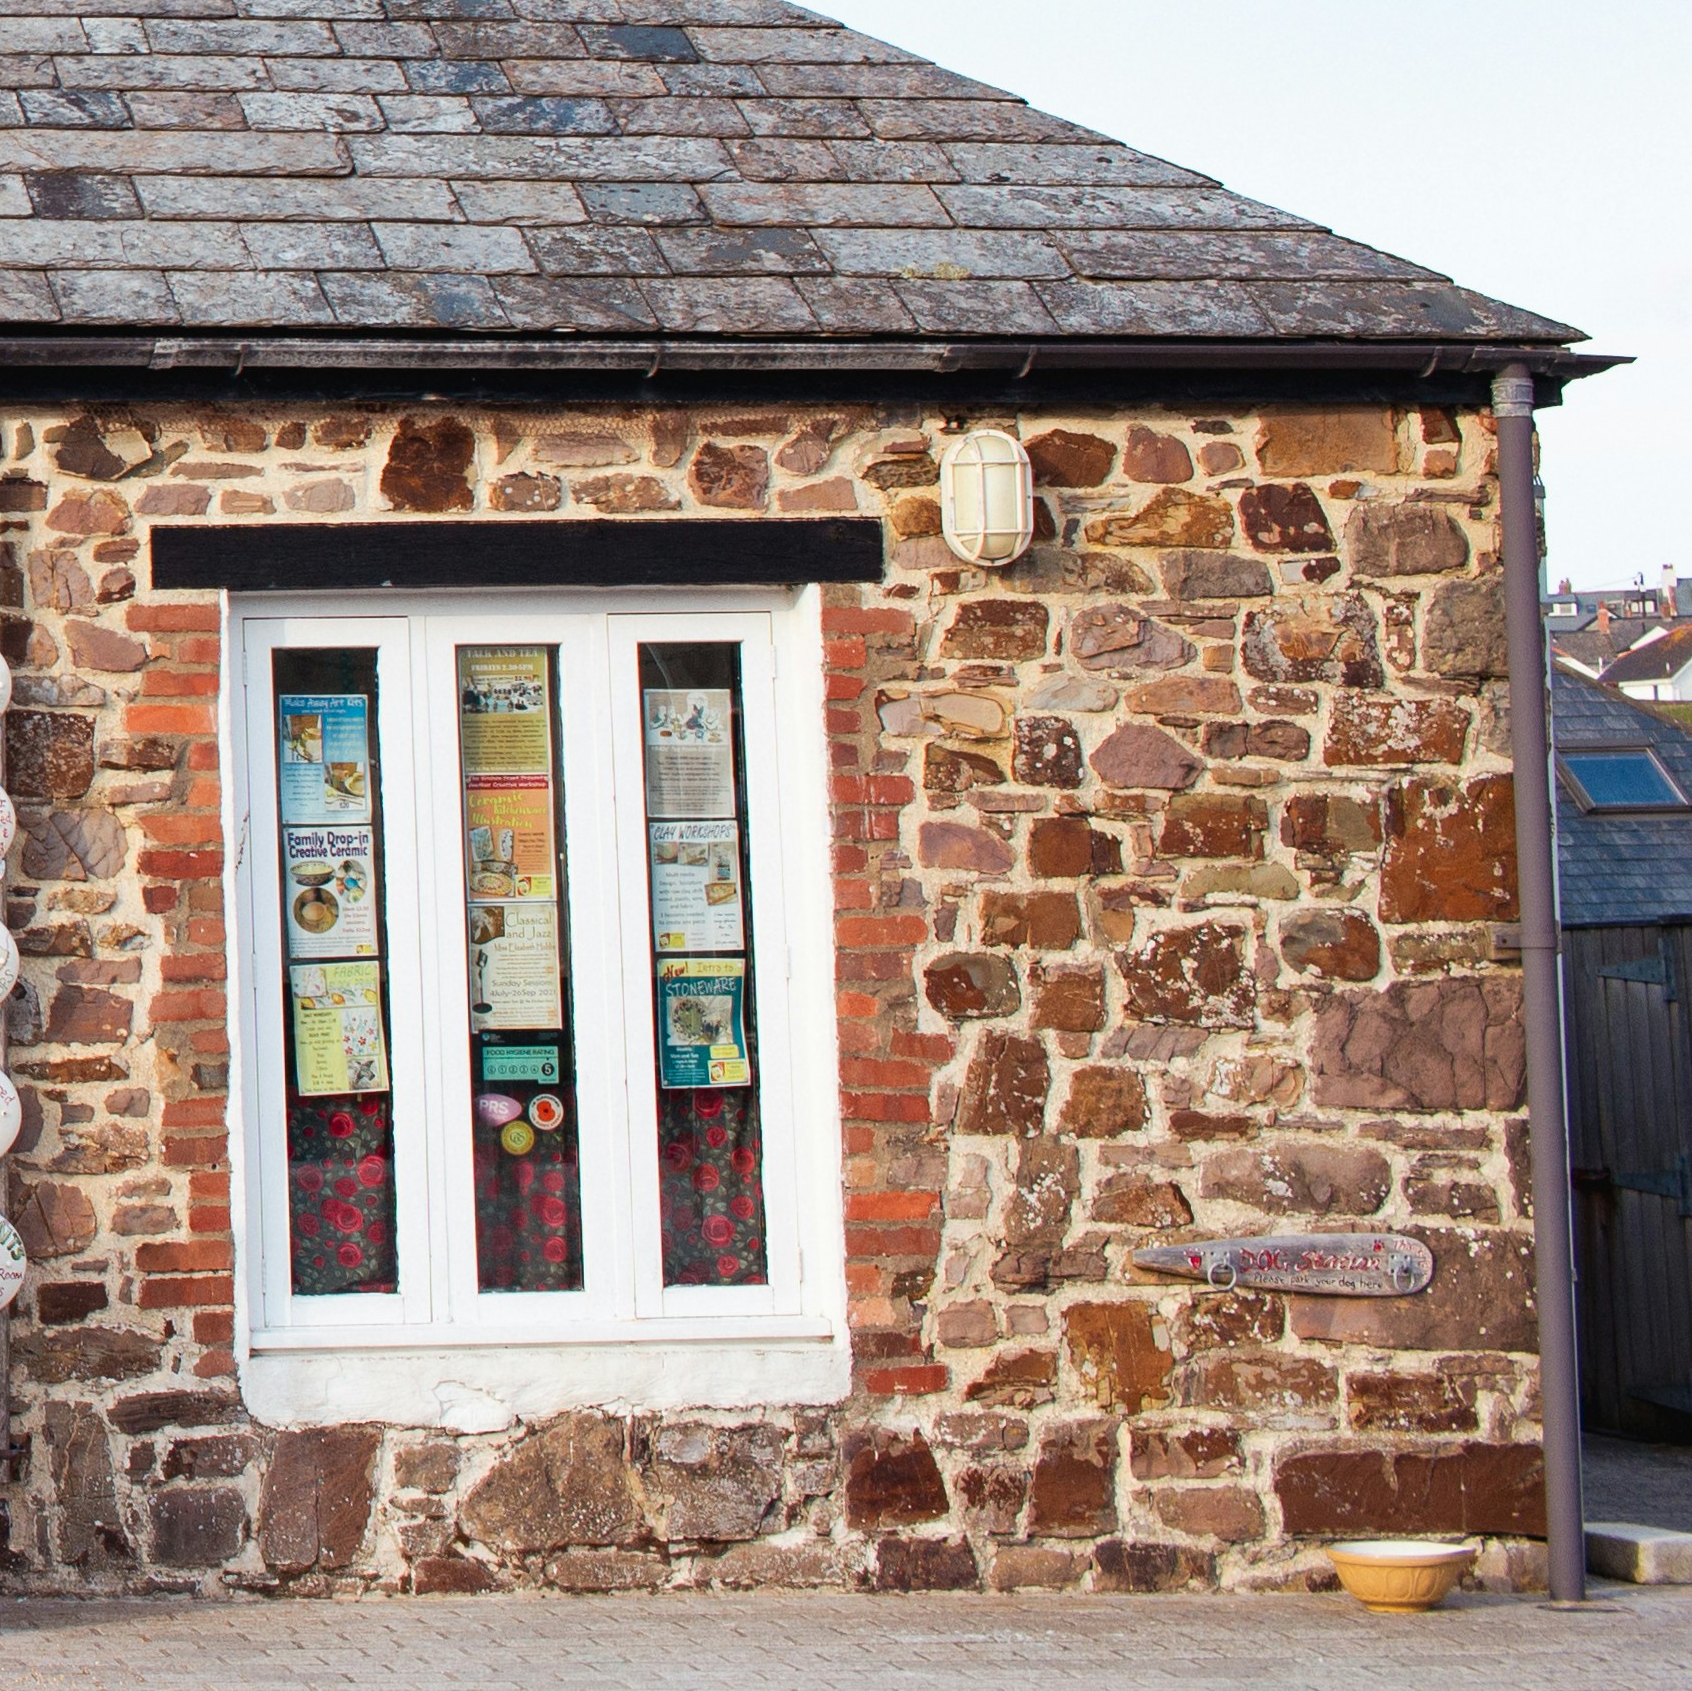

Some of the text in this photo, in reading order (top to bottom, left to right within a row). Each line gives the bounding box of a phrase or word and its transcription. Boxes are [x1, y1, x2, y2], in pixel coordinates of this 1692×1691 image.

[494, 649, 516, 658] AND
[287, 831, 369, 847] Family Drop-in
[653, 824, 731, 840] CLAY WORKSHOPS
[289, 843, 368, 858] Creative Ceramic
[505, 912, 552, 928] Classical
[506, 926, 552, 940] and Jazz
[333, 965, 371, 978] FABRIC
[697, 962, 722, 973] Intro
[724, 962, 734, 972] to
[492, 979, 521, 988] Sunday
[665, 976, 737, 997] STONEWARE
[544, 1063, 552, 1075] 5
[479, 1099, 510, 1115] PRS
[1238, 1247, 1290, 1273] DOG
[1254, 1271, 1284, 1285] Please
[1338, 1275, 1356, 1290] dog
[1359, 1276, 1384, 1288] here
